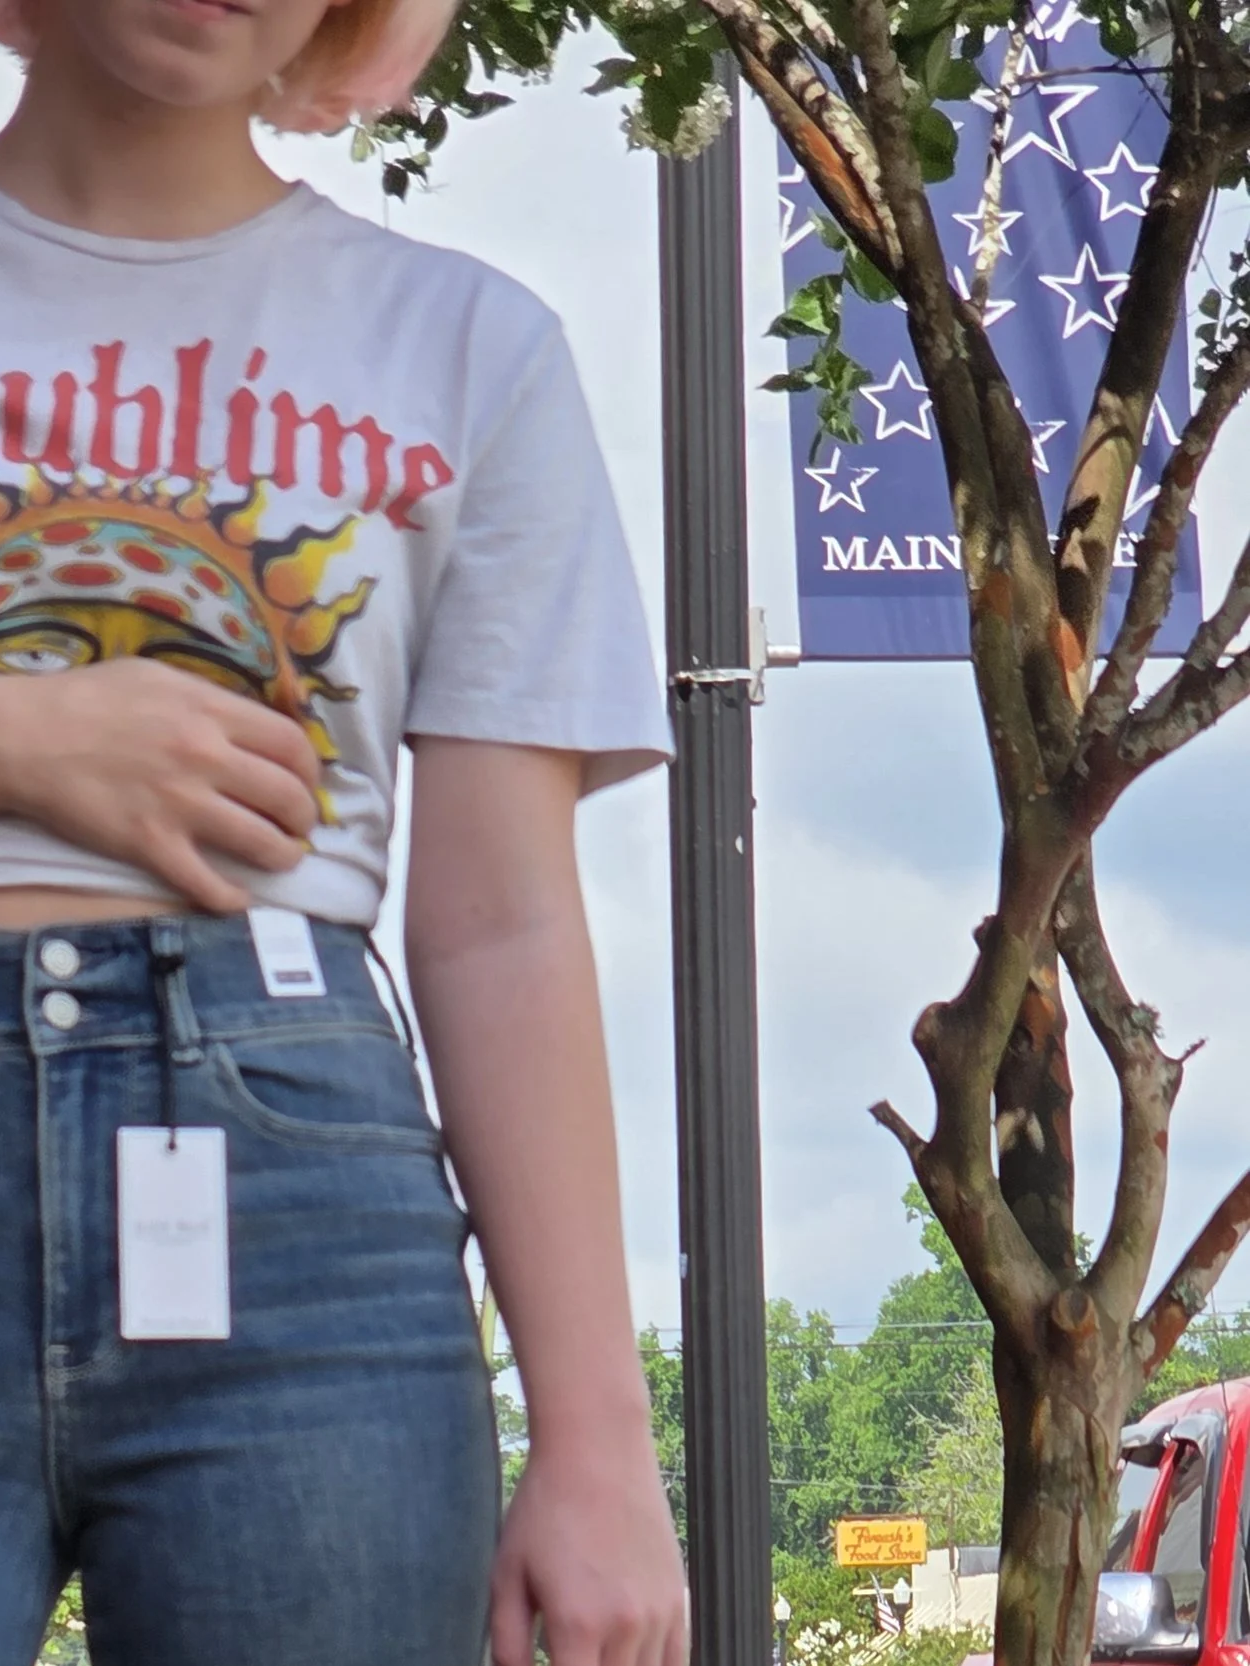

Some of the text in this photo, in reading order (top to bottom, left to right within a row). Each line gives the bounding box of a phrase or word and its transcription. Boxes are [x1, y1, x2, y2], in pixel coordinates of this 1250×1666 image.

[821, 534, 962, 570] MAIN
[844, 1543, 922, 1561] Food Store
